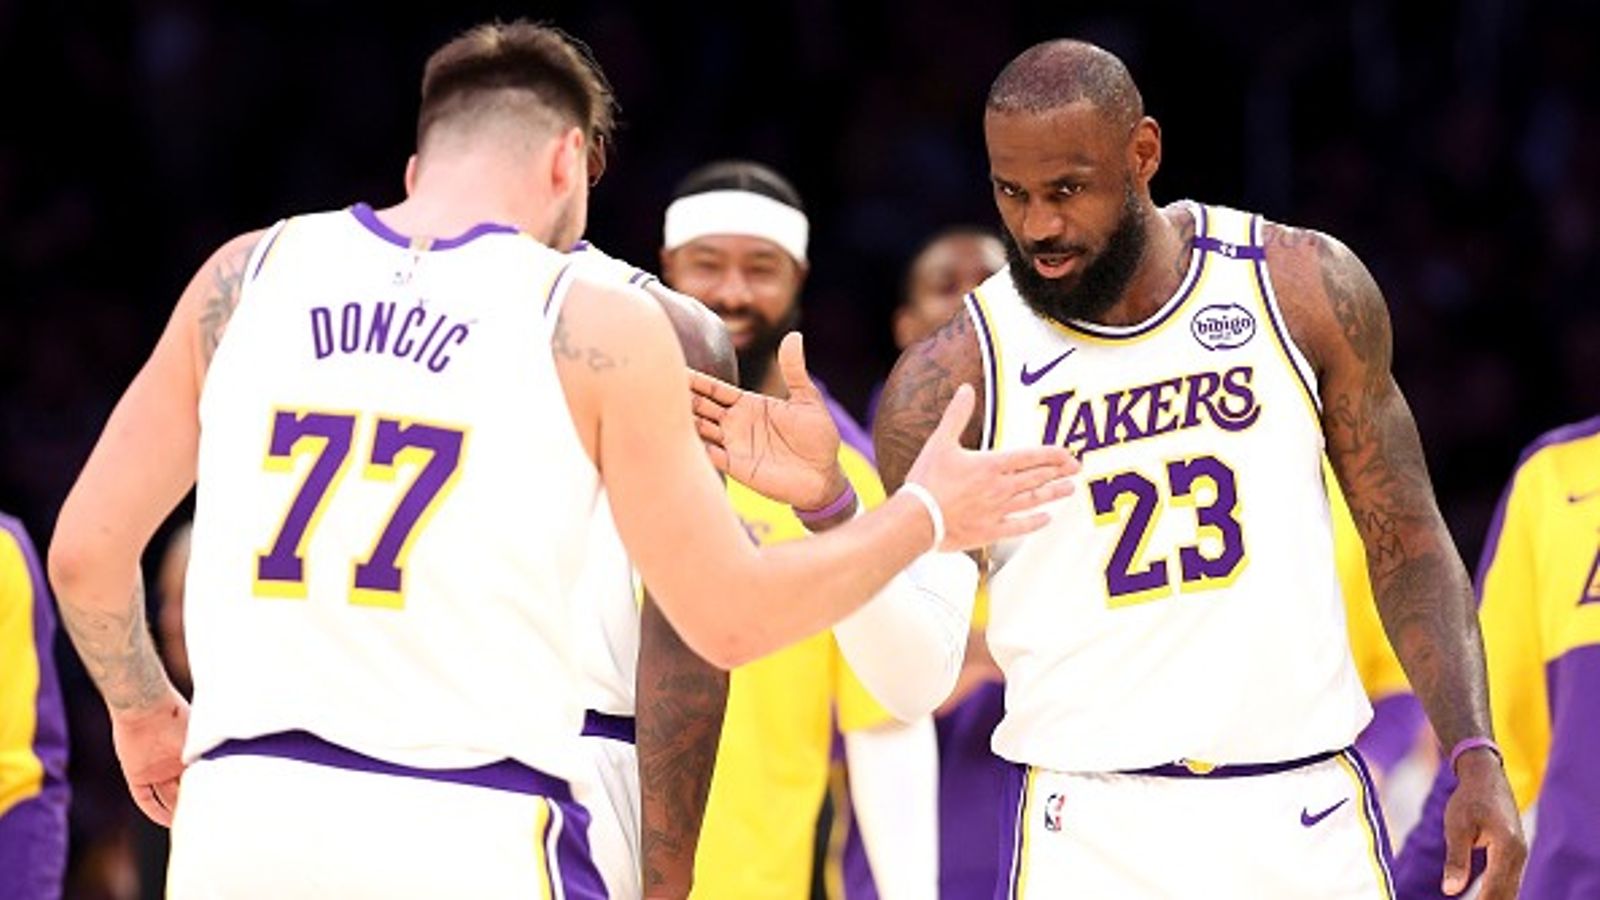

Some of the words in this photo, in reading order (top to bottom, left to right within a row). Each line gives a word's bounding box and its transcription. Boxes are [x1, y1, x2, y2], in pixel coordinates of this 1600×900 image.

[1197, 315, 1251, 335] bibigo
[253, 405, 469, 607] 77
[1088, 455, 1246, 606] 23
